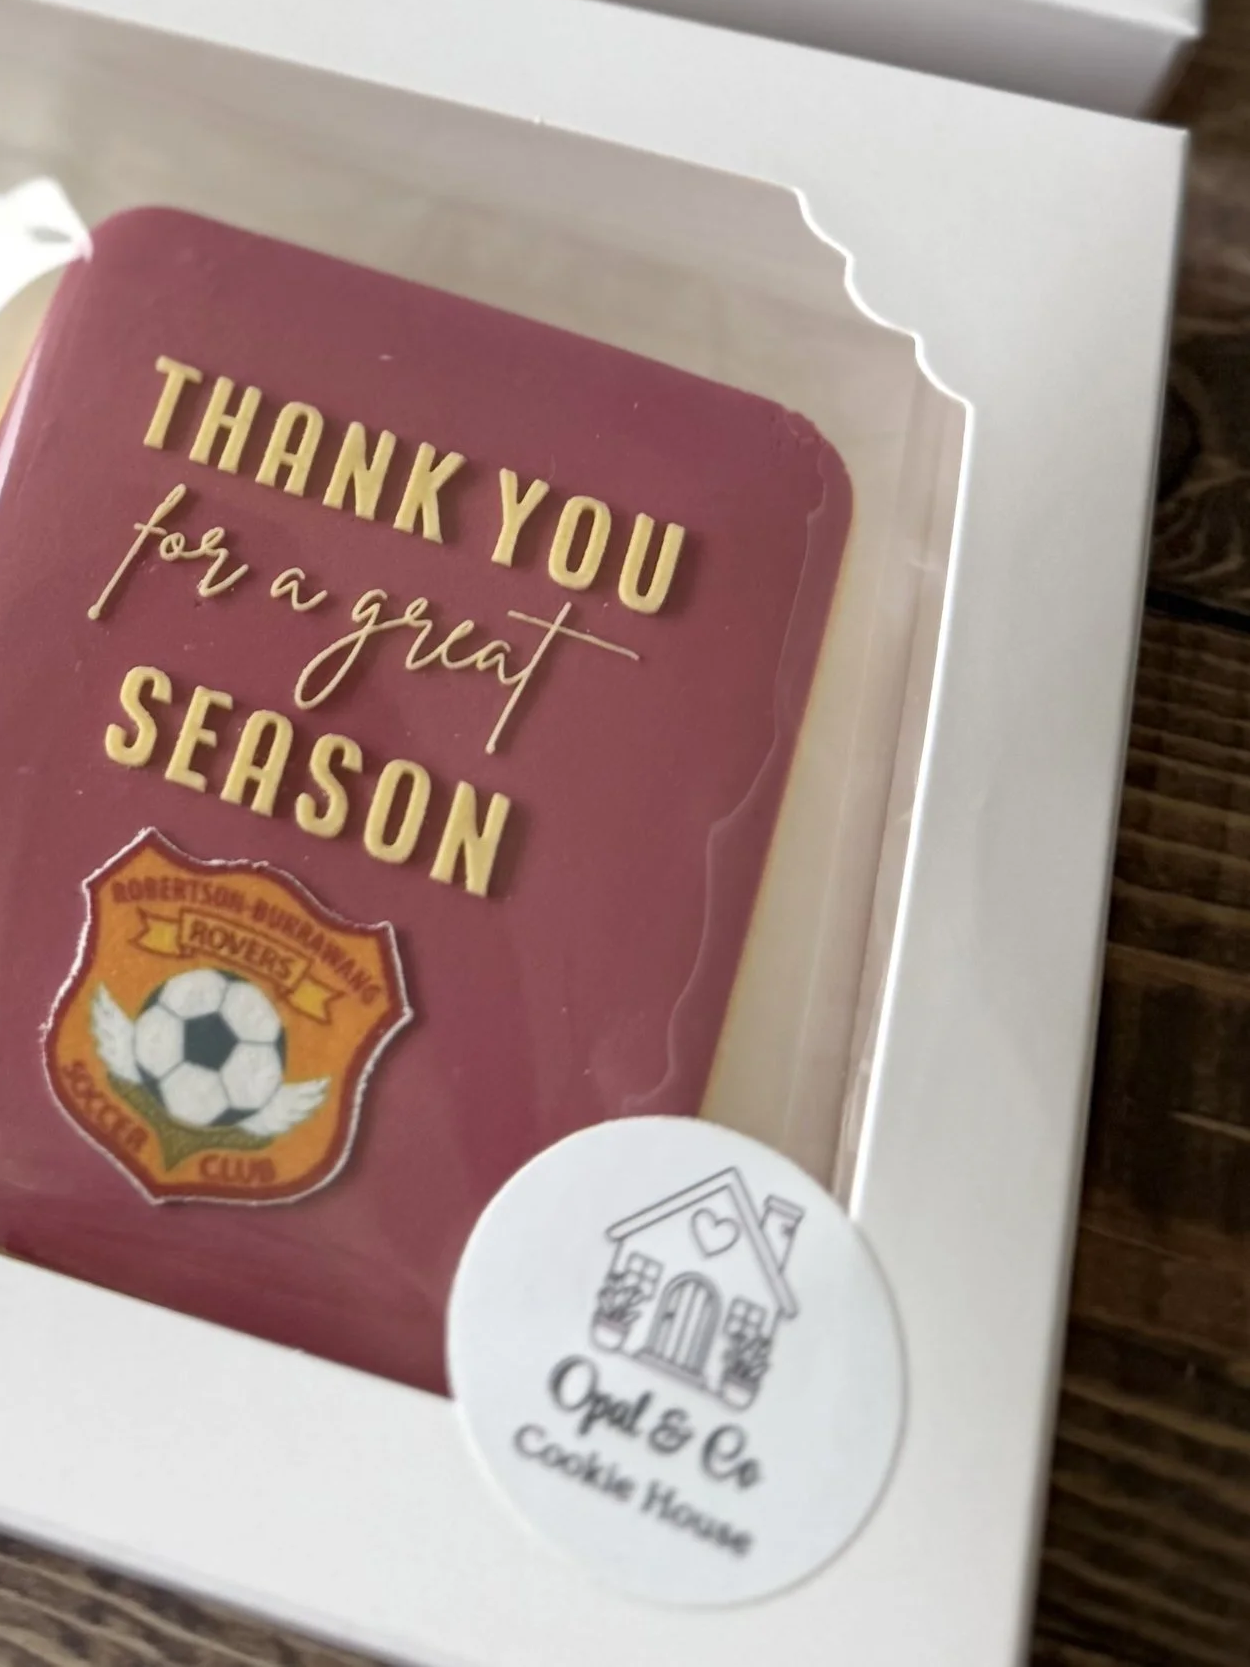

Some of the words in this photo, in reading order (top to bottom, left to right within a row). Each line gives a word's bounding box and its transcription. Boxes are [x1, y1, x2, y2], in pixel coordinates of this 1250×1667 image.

[86, 482, 249, 622] for
[143, 353, 467, 545] THANK
[490, 466, 686, 616] YOU
[269, 564, 328, 612] a
[293, 586, 642, 755] great
[103, 664, 512, 899] SEASON
[186, 918, 297, 984] ROVERS
[198, 1152, 277, 1186] CLUB
[548, 1354, 653, 1436] Opal
[649, 1406, 695, 1455] &
[700, 1425, 763, 1489] Co
[513, 1425, 637, 1501] Cookie
[643, 1479, 755, 1557] House
